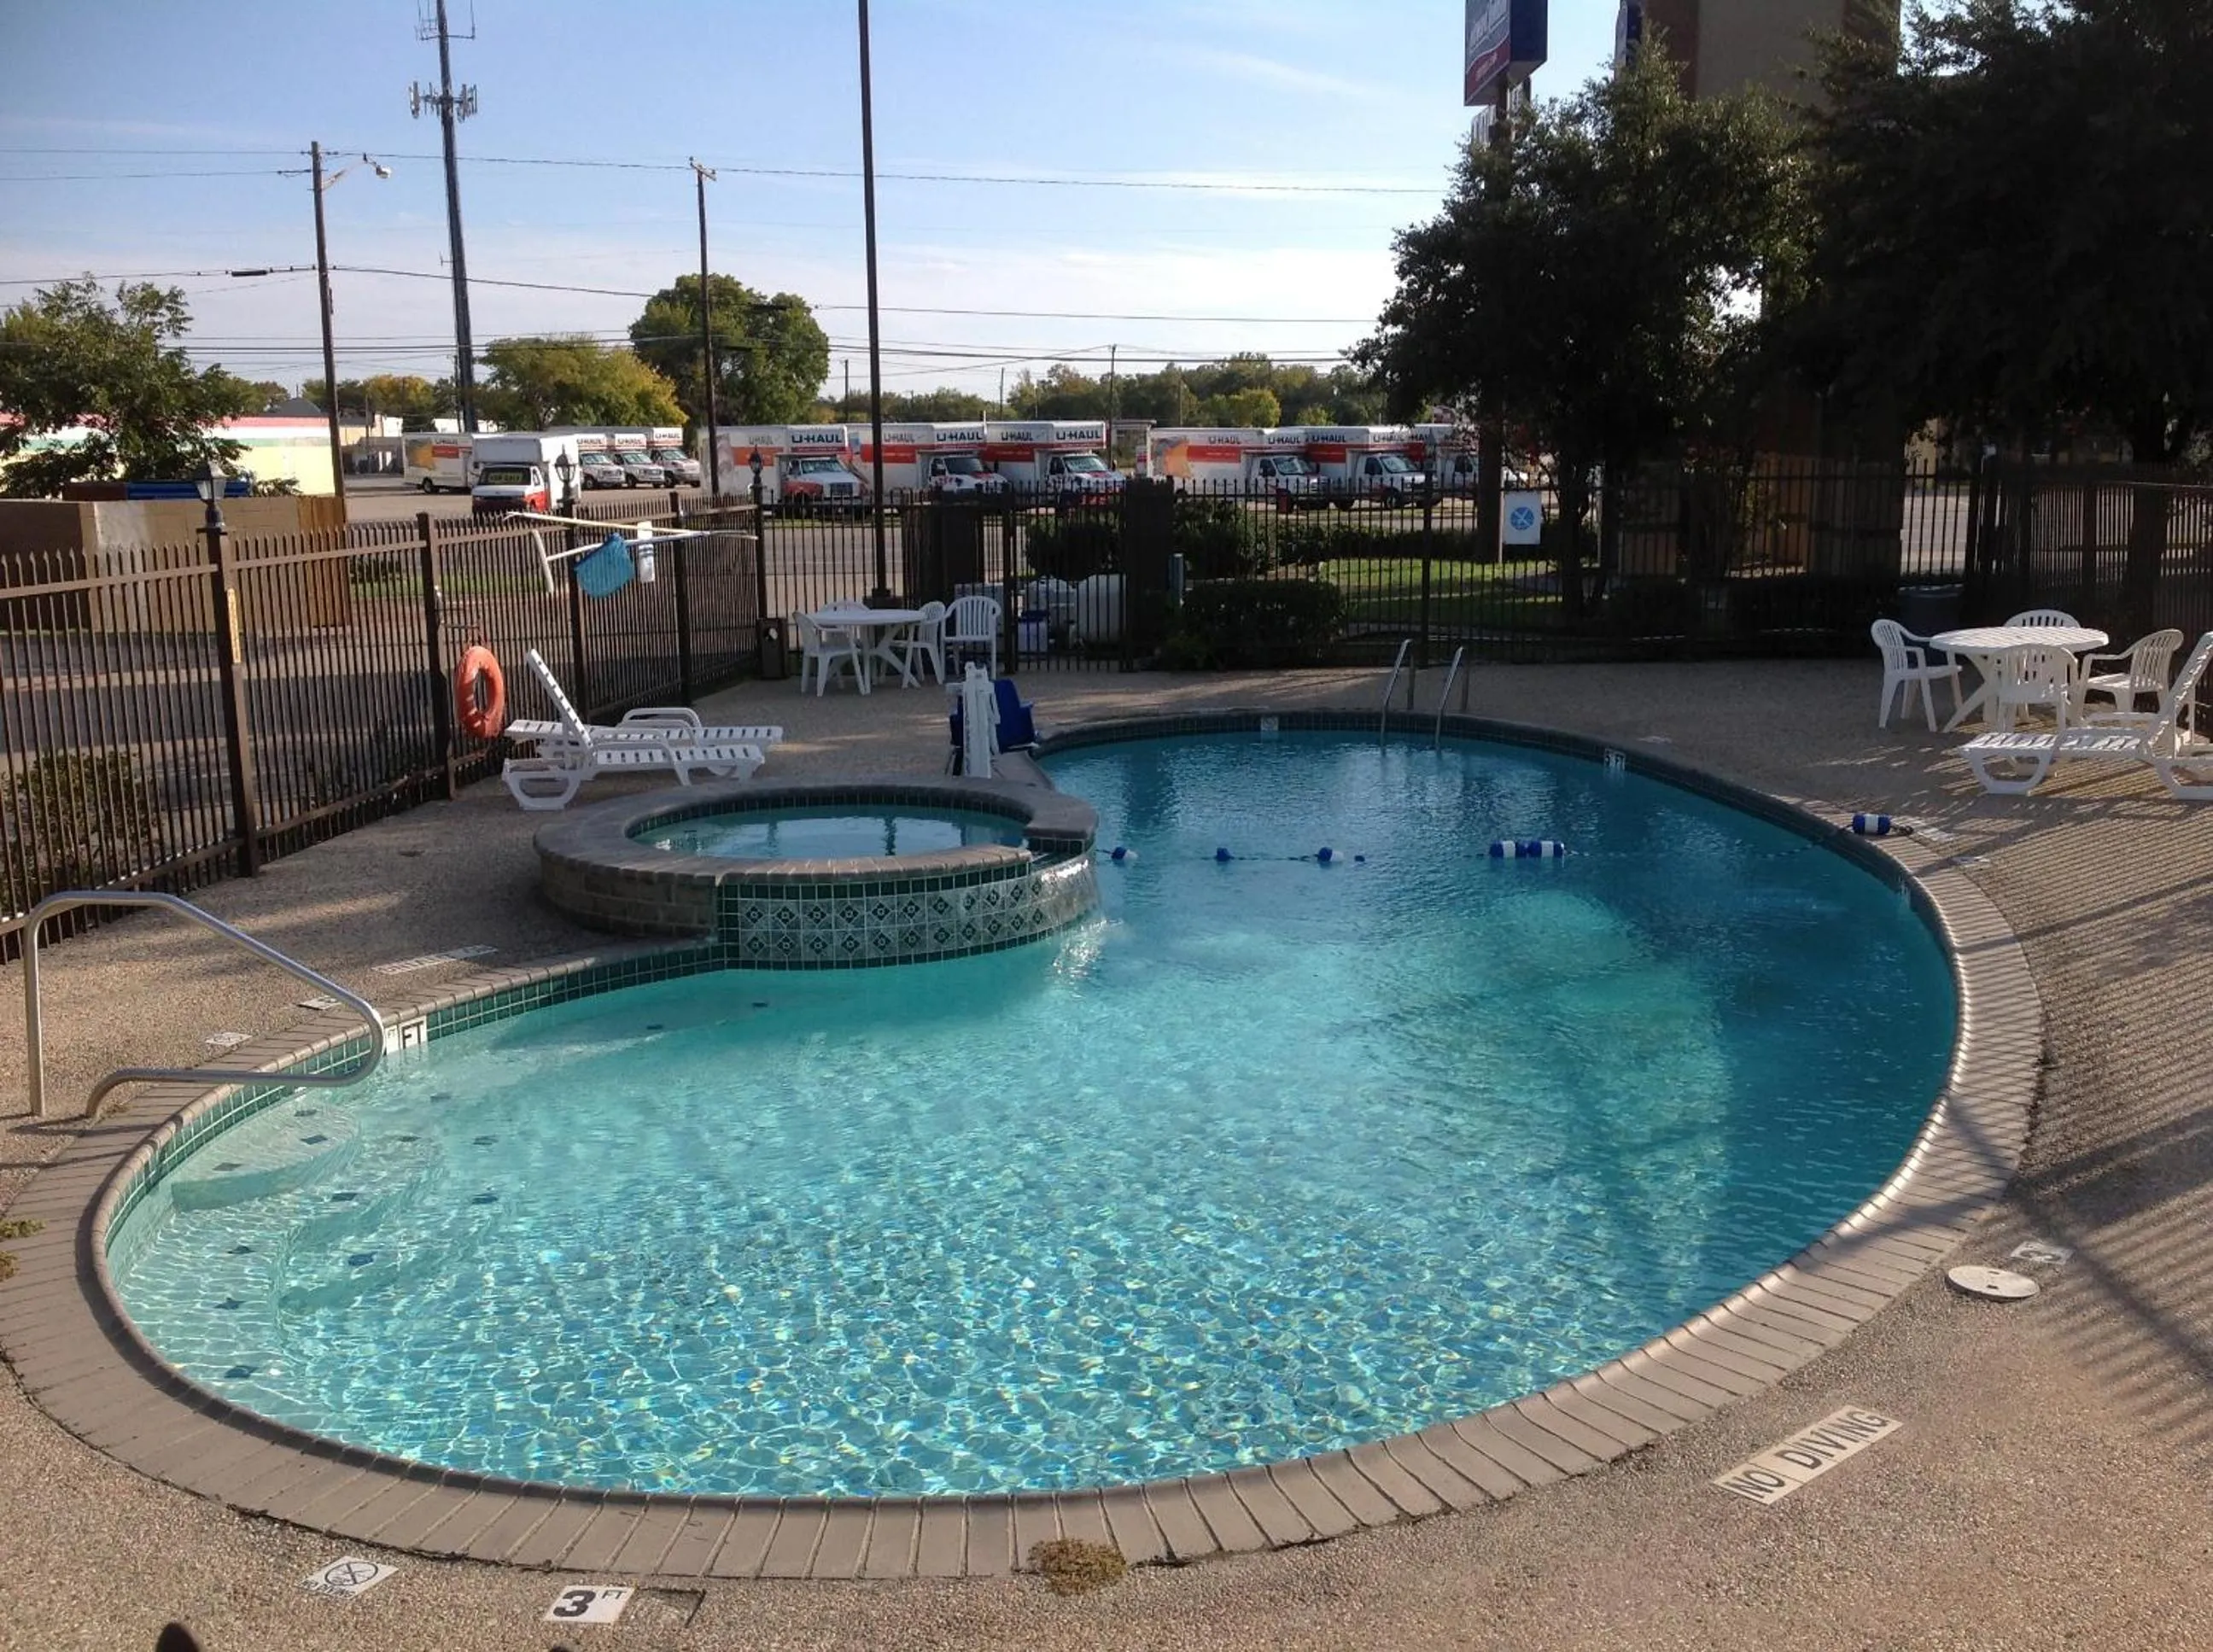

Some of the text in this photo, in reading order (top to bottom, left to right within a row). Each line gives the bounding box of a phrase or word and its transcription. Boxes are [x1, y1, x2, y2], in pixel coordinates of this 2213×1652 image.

[791, 433, 842, 443] U-HAUL
[937, 431, 984, 441] U-HAUL
[1001, 431, 1034, 441] U-HAUL
[1056, 429, 1101, 441] U-HAUL
[1268, 435, 1301, 445] U-HAUL
[400, 1019, 424, 1050] FT
[1722, 1410, 1890, 1500] NO DIVING
[552, 1589, 626, 1619] 3 FT
